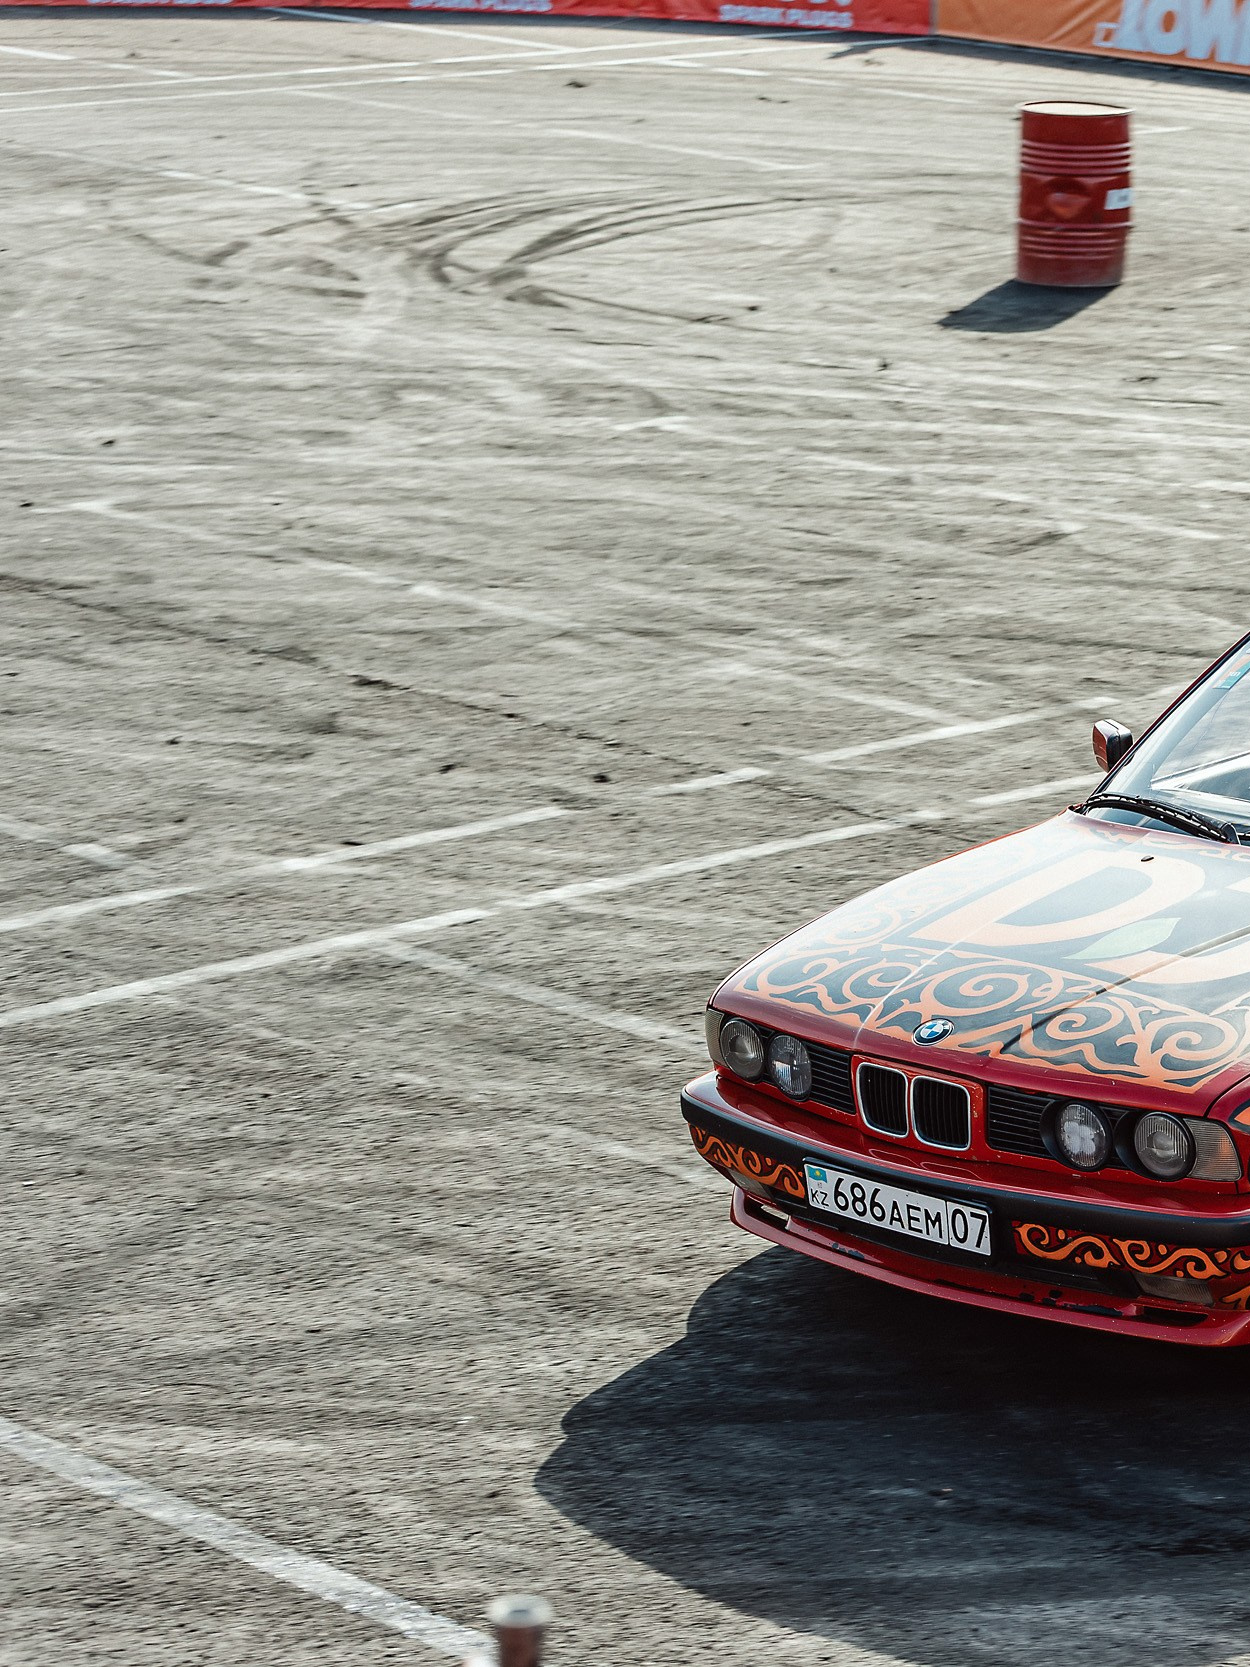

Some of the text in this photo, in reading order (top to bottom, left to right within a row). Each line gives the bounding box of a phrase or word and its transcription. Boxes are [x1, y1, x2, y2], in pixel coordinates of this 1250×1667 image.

[810, 1177, 987, 1249] KZ 686AEM 07
